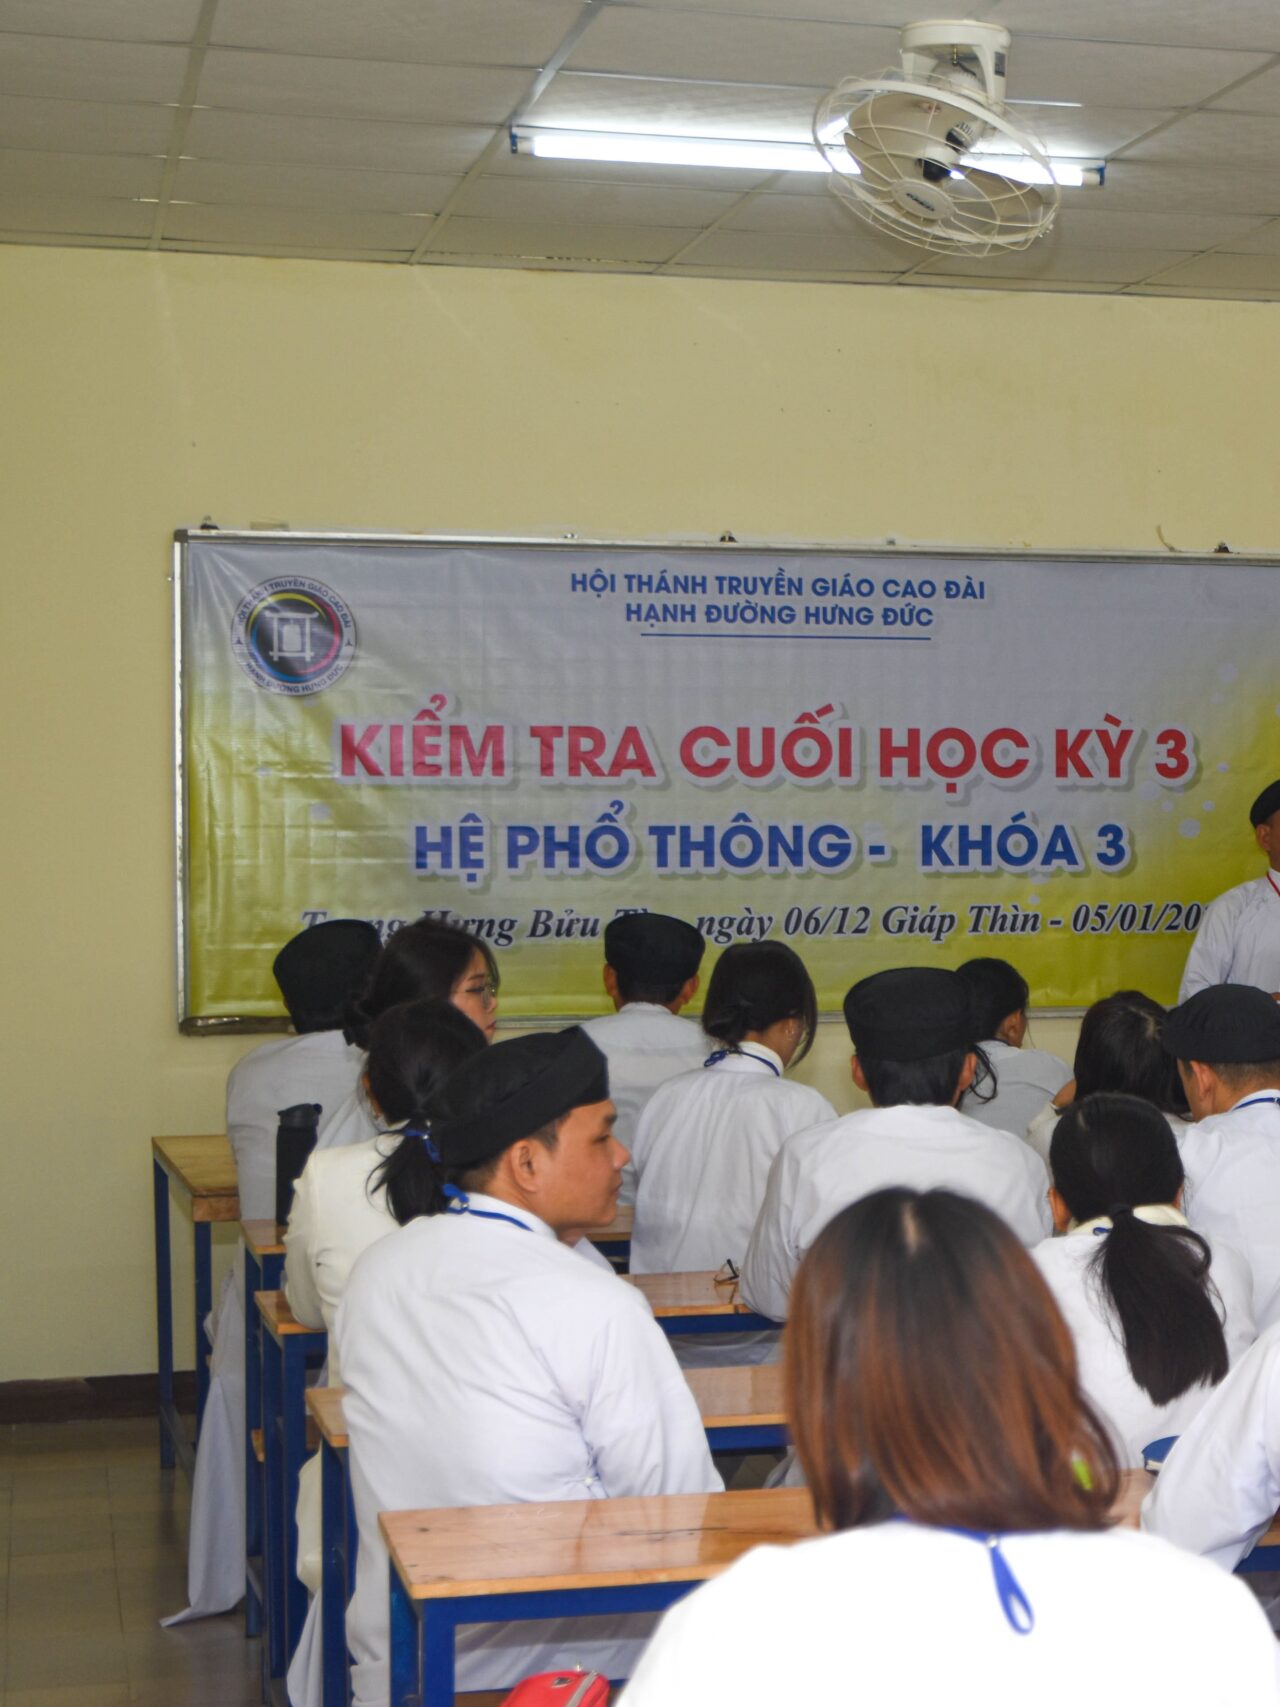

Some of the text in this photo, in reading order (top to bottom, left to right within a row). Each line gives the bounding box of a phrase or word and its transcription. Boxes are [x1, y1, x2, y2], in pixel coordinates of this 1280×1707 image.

[571, 567, 986, 600] HỘI THÁNH TRUYỀN GIÁO CAO ĐÀI
[625, 599, 934, 628] HẠNH ĐƯỜNG HƯNG ĐỨC
[341, 694, 1189, 793] KIỂM TRA CUỐI HỌC KỲ 3
[415, 812, 485, 882] HỆ
[506, 799, 630, 870] PHỔ
[647, 811, 853, 869] THÔNG
[921, 810, 1079, 867] KHÓA
[1096, 823, 1127, 867] 3
[526, 909, 600, 938] Bửu
[696, 907, 773, 944] ngày
[784, 906, 871, 935] 06/12
[882, 905, 956, 941] Giáp
[969, 905, 1040, 933] Thìn
[1072, 903, 1210, 932] 05/01/20
